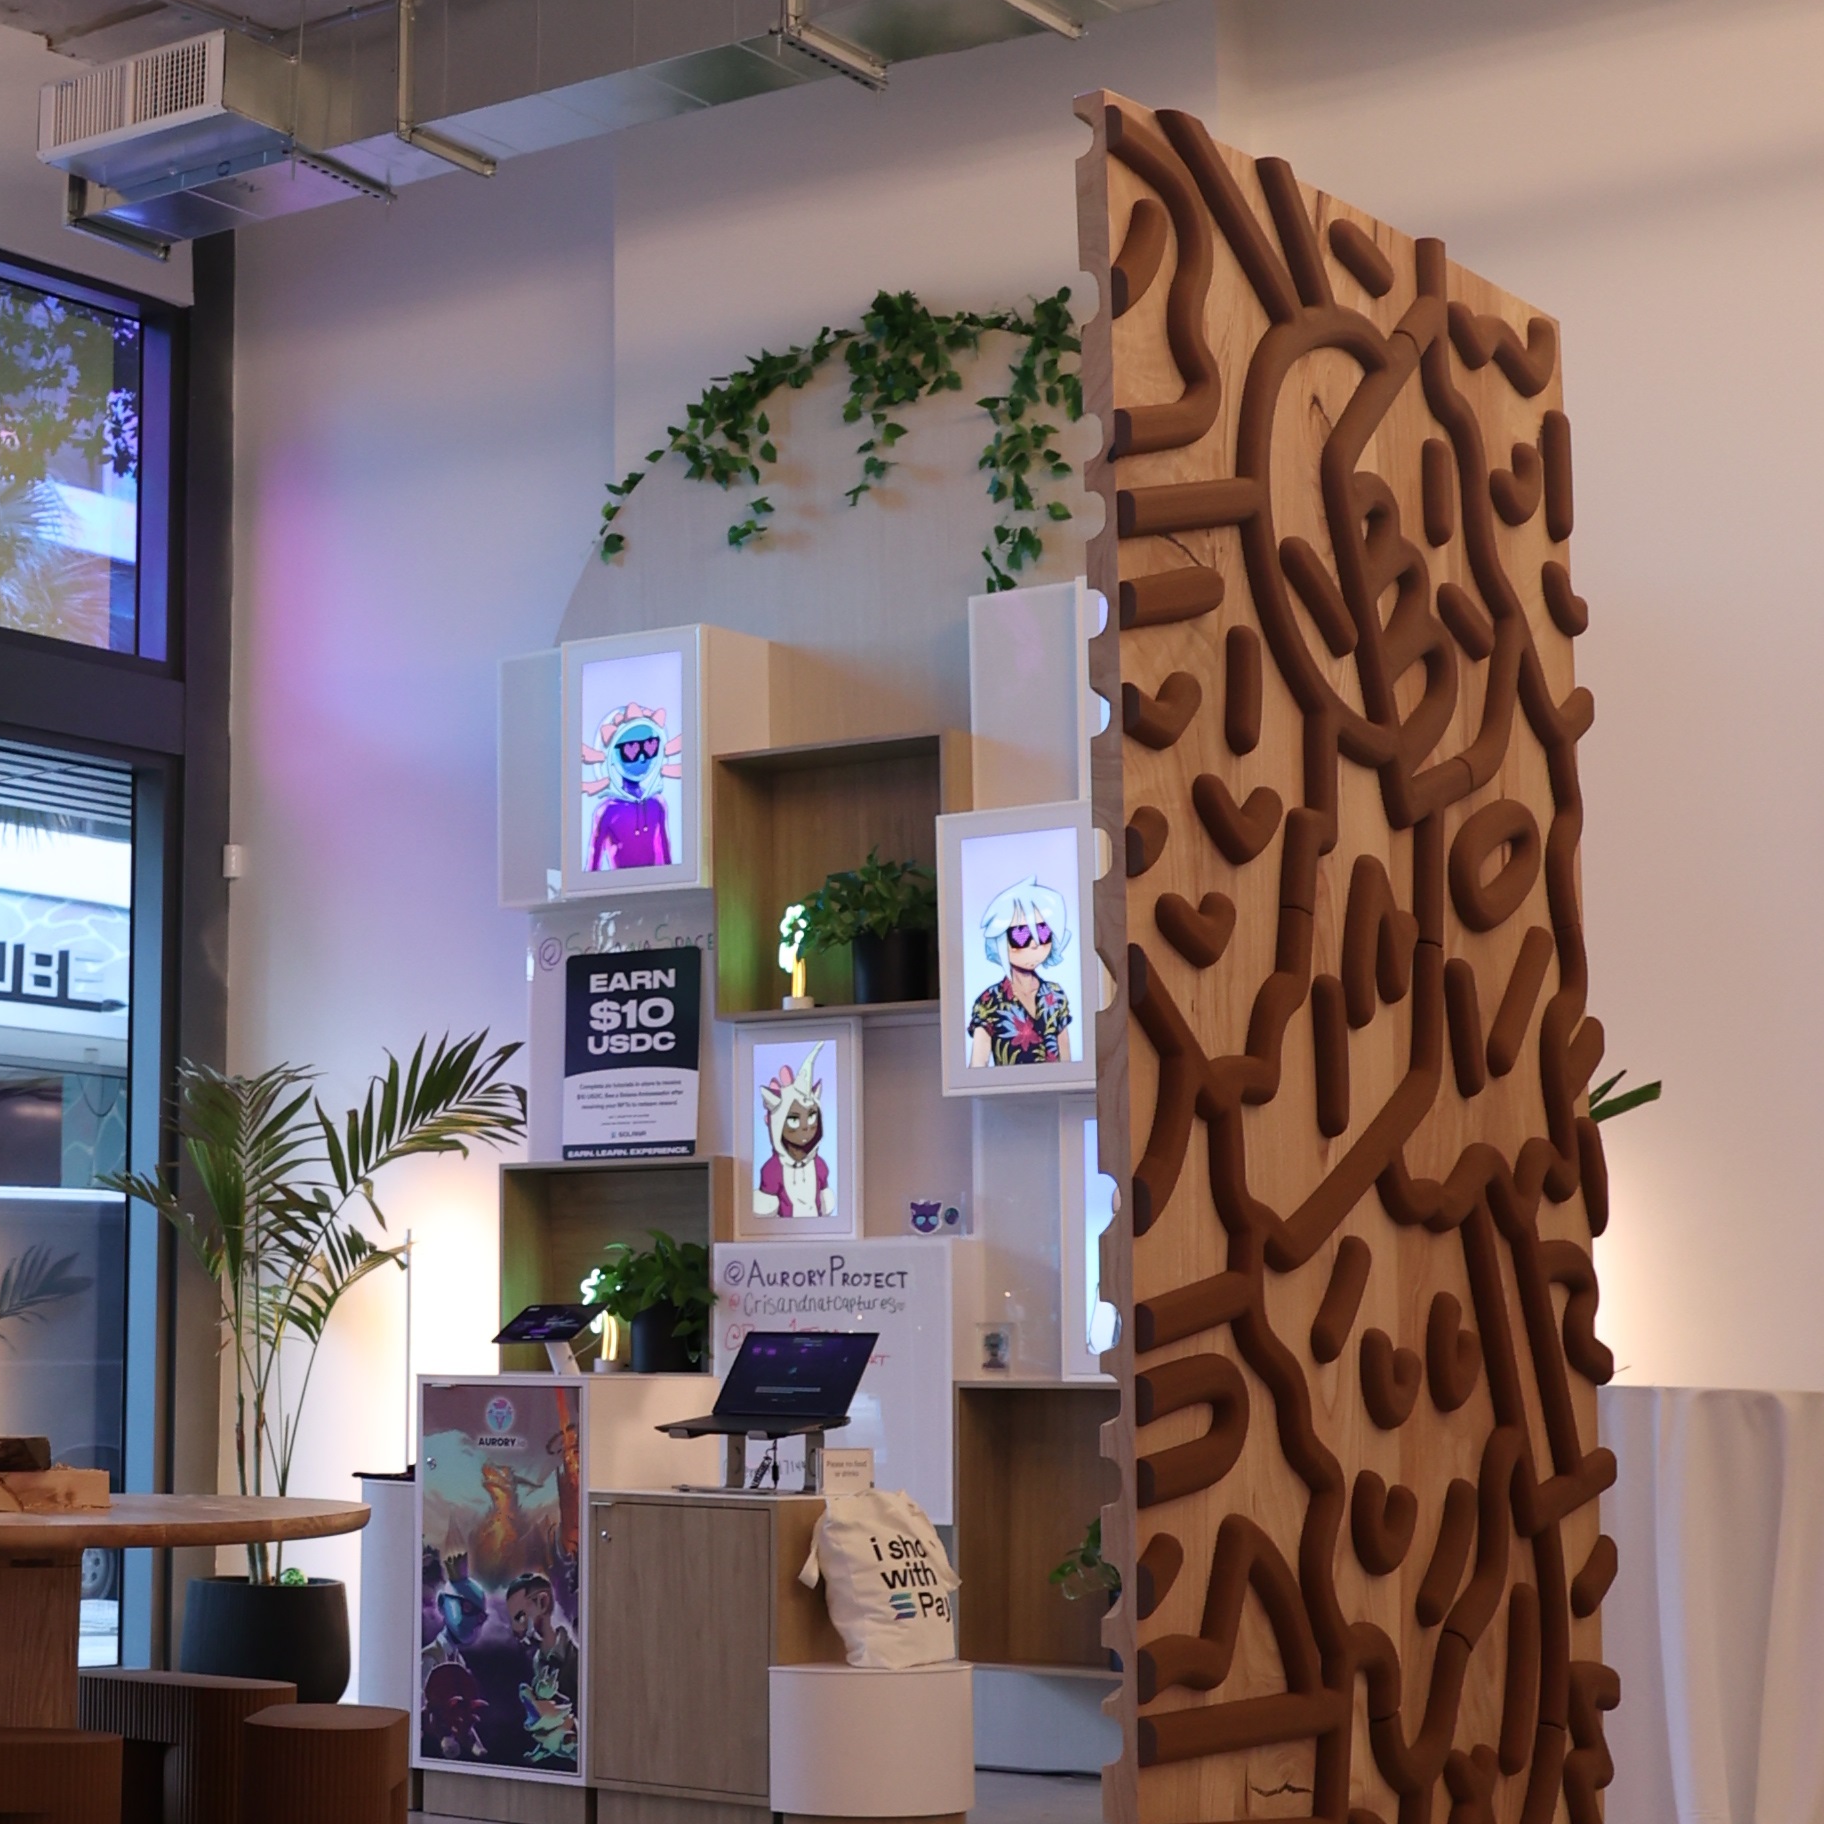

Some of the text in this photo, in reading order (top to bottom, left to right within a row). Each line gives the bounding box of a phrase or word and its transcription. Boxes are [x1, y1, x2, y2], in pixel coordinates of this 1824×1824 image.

[589, 969, 676, 993] EARN
[589, 997, 675, 1033] $10
[588, 1031, 676, 1055] USDC
[870, 1535, 932, 1561] i sho
[880, 1560, 938, 1589] with
